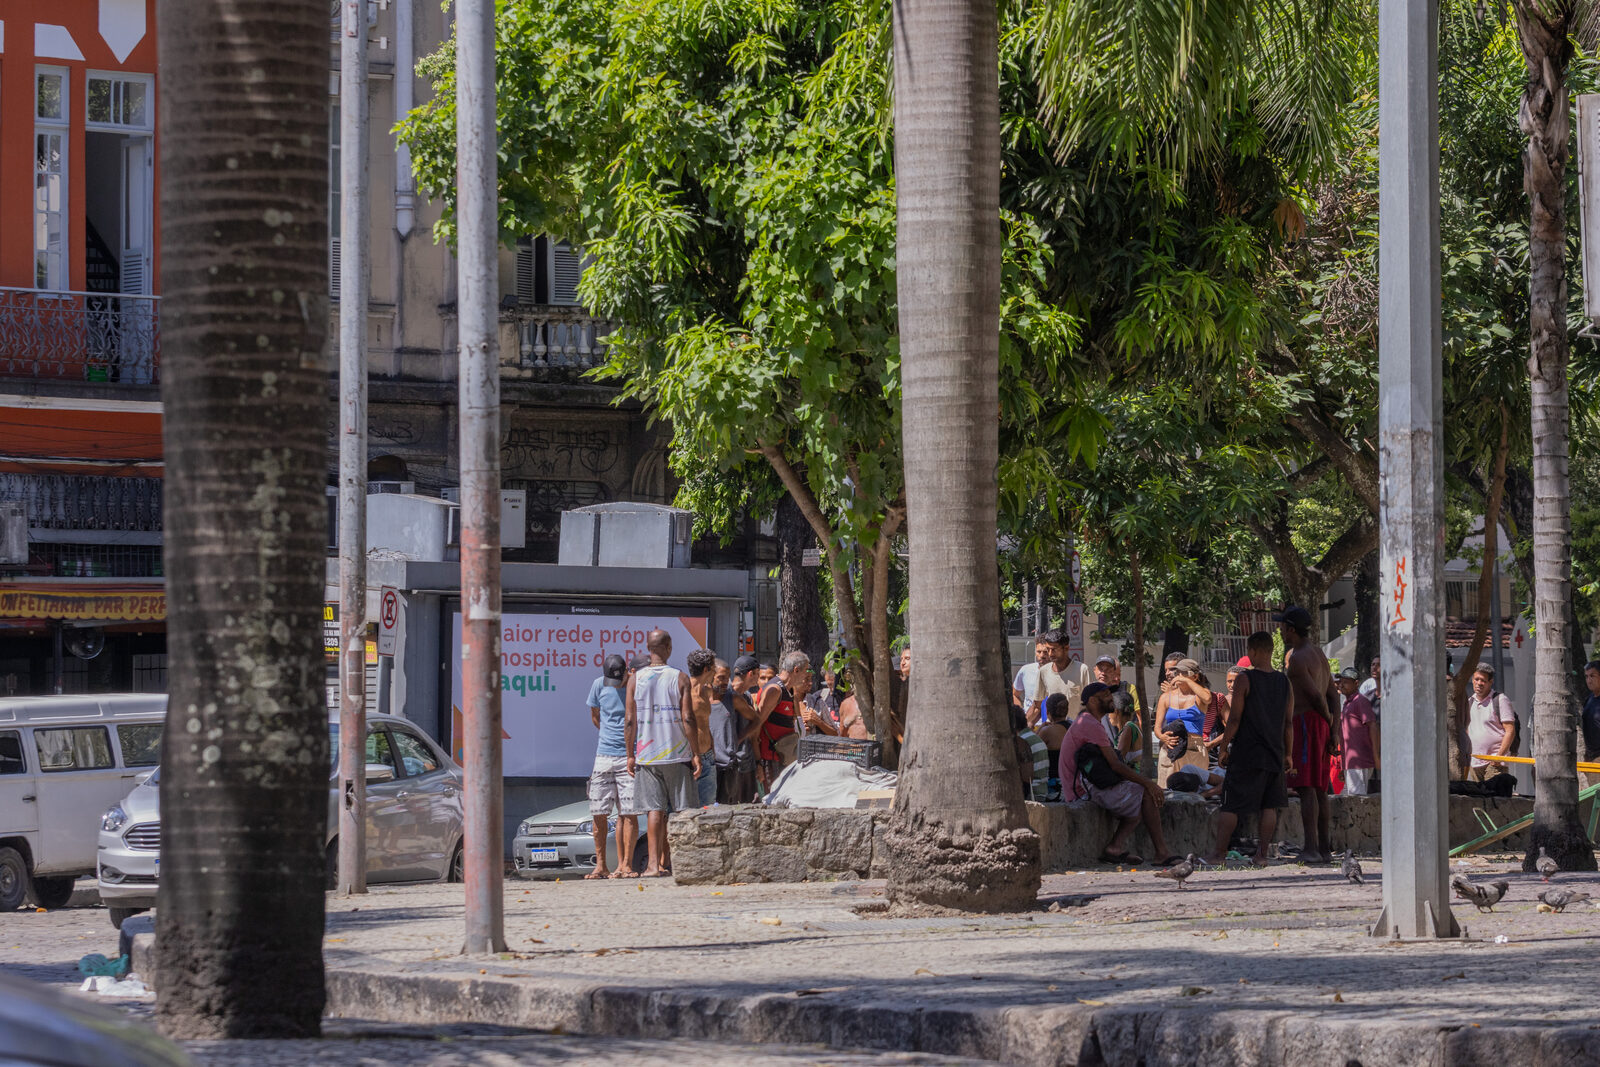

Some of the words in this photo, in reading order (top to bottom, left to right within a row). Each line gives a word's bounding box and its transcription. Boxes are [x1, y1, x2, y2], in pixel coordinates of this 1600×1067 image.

[1, 593, 86, 613] ONFEITARIA
[504, 624, 542, 643] aior
[547, 624, 594, 643] rede
[600, 625, 658, 649] própr
[593, 649, 605, 667] d
[501, 670, 556, 697] aqui.
